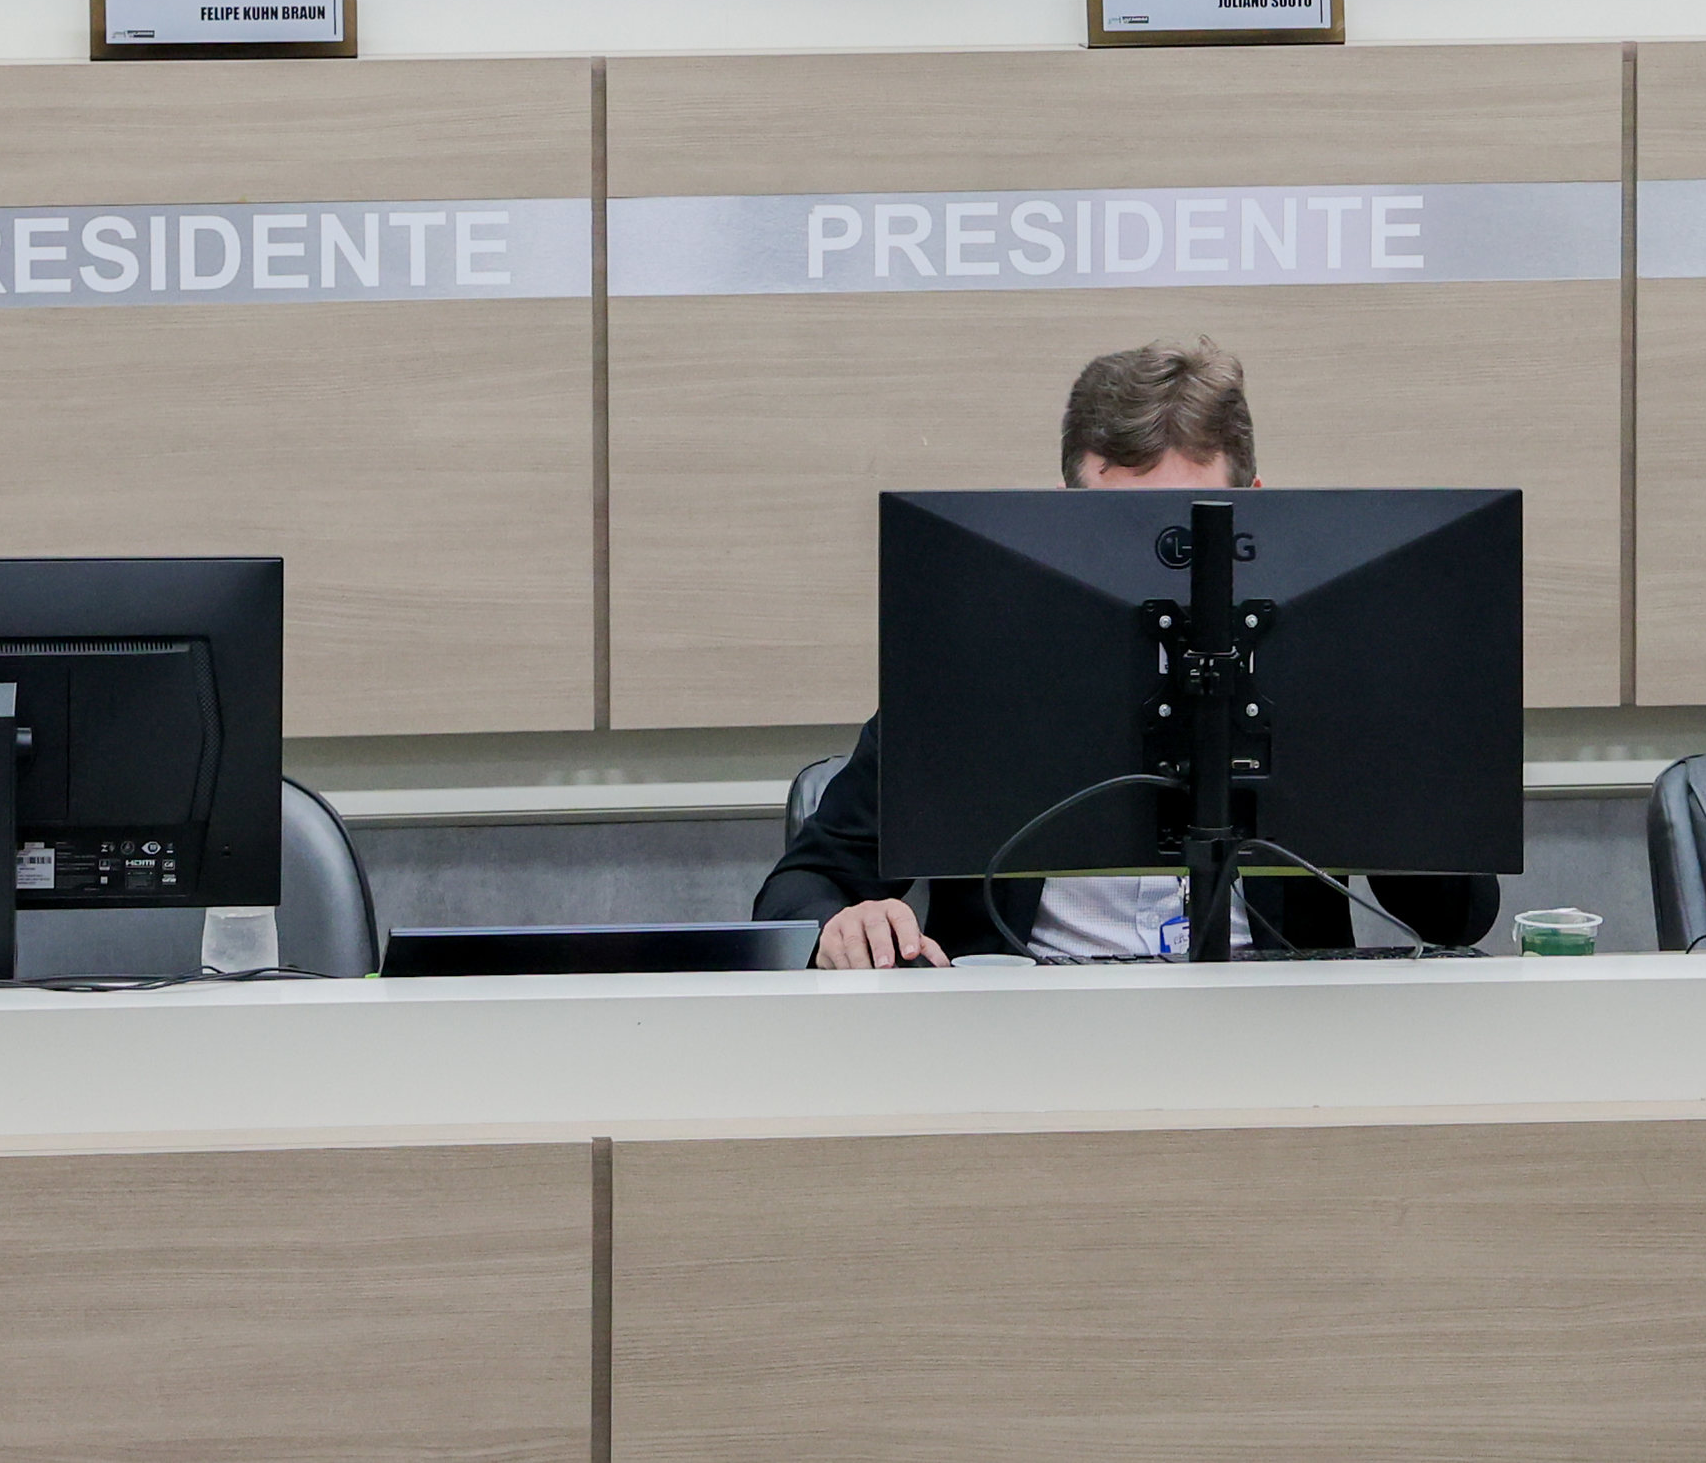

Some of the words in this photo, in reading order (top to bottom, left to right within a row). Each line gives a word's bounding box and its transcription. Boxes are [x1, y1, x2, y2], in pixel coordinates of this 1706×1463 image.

[200, 6, 240, 21] FELIPE
[243, 6, 279, 21] KUHN
[282, 5, 326, 20] BRAUN
[807, 194, 1425, 279] PRESIDENTE
